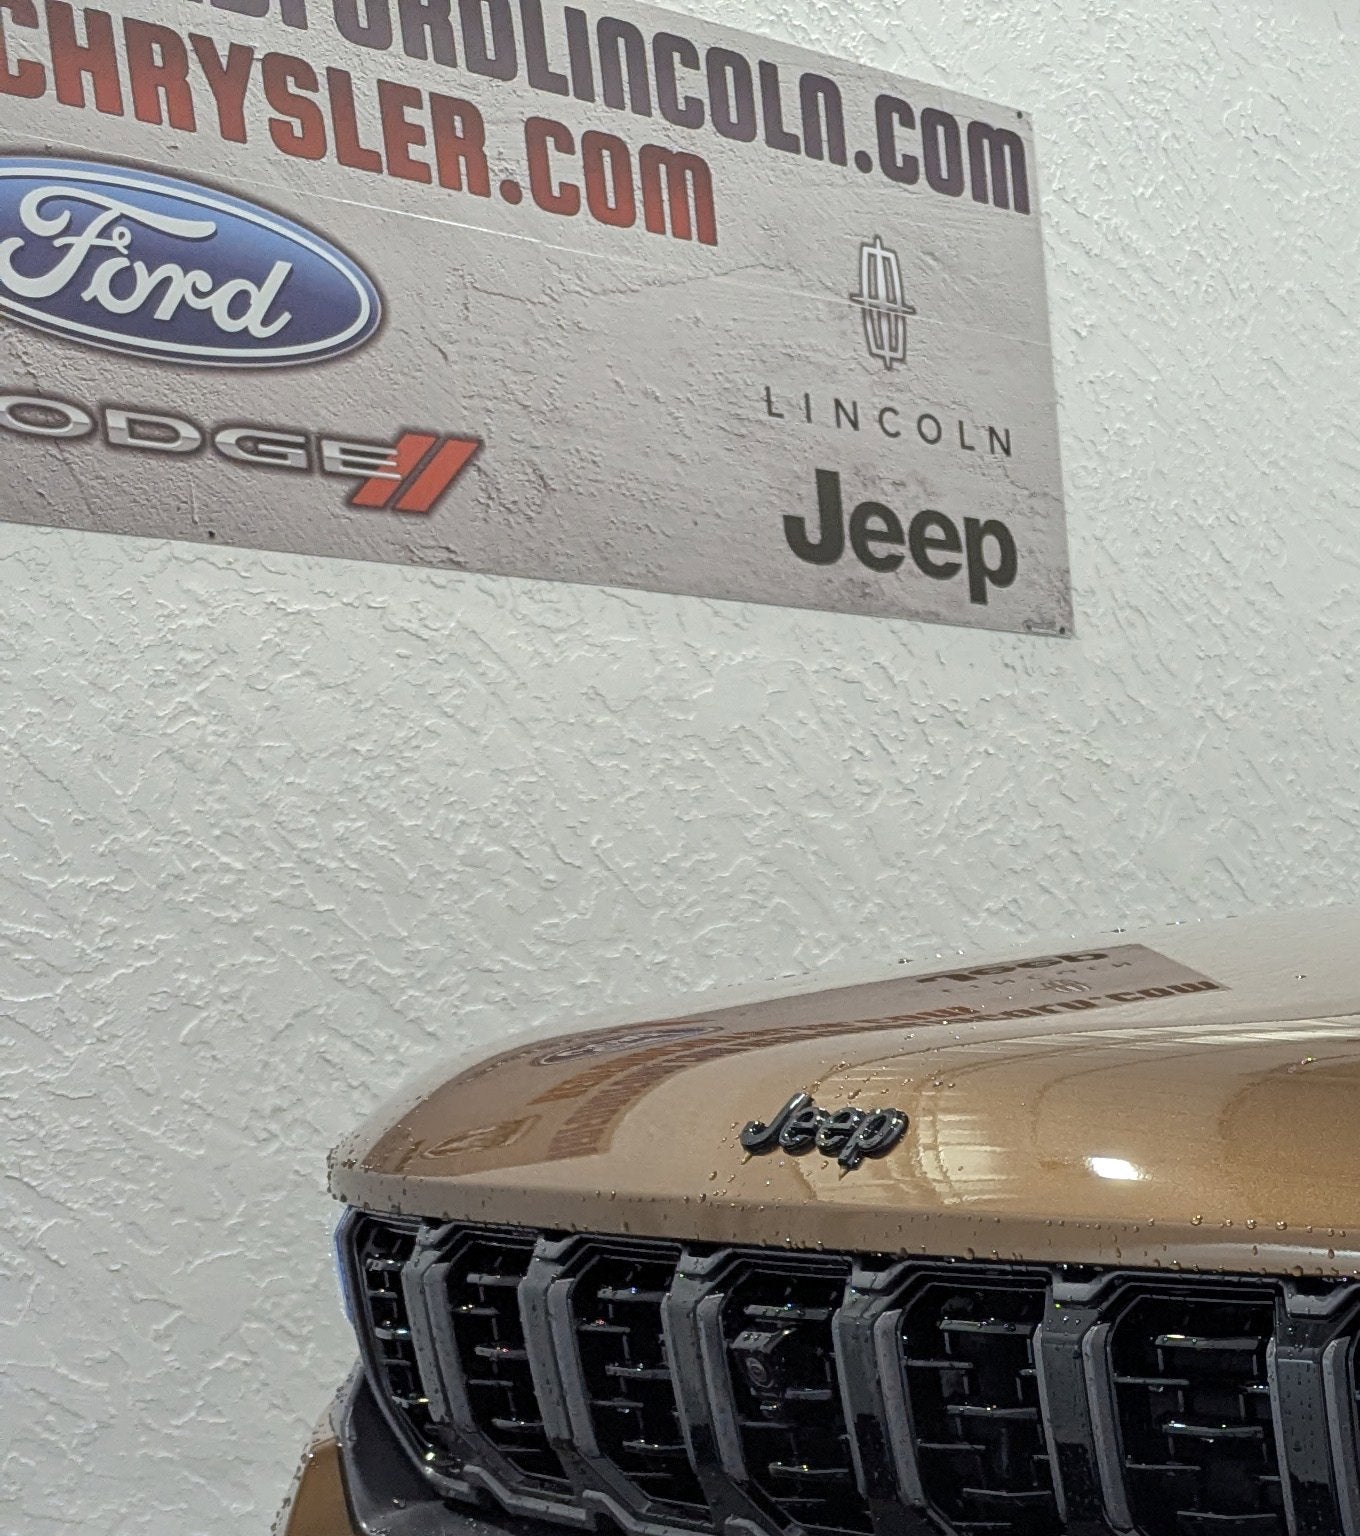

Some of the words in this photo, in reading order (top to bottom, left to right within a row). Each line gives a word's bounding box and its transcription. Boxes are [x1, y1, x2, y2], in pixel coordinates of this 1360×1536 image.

[0, 185, 293, 339] Ford
[764, 386, 1012, 457] LINCOLN
[782, 468, 1018, 606] Jeep
[740, 1092, 909, 1170] Jeep
